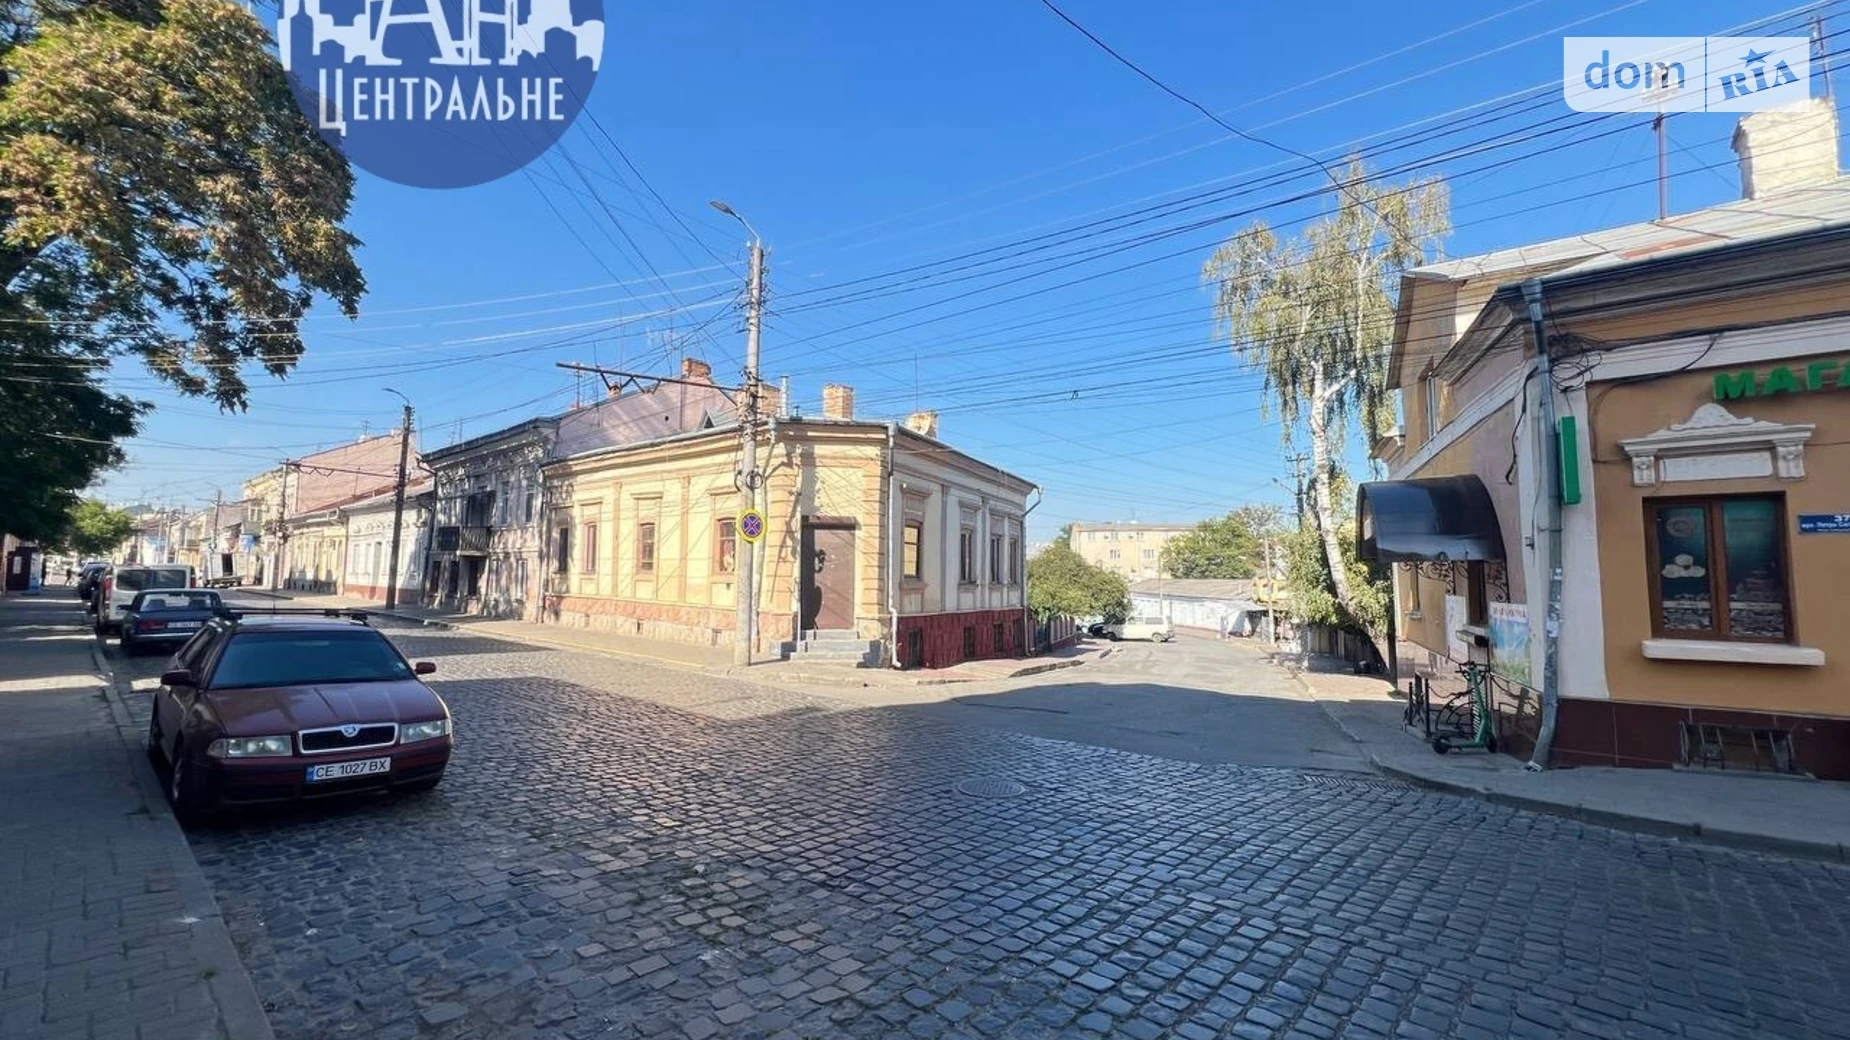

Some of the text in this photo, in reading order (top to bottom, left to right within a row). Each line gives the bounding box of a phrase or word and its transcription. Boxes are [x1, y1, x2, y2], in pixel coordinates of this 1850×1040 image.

[316, 760, 387, 778] CE 1027 BX
